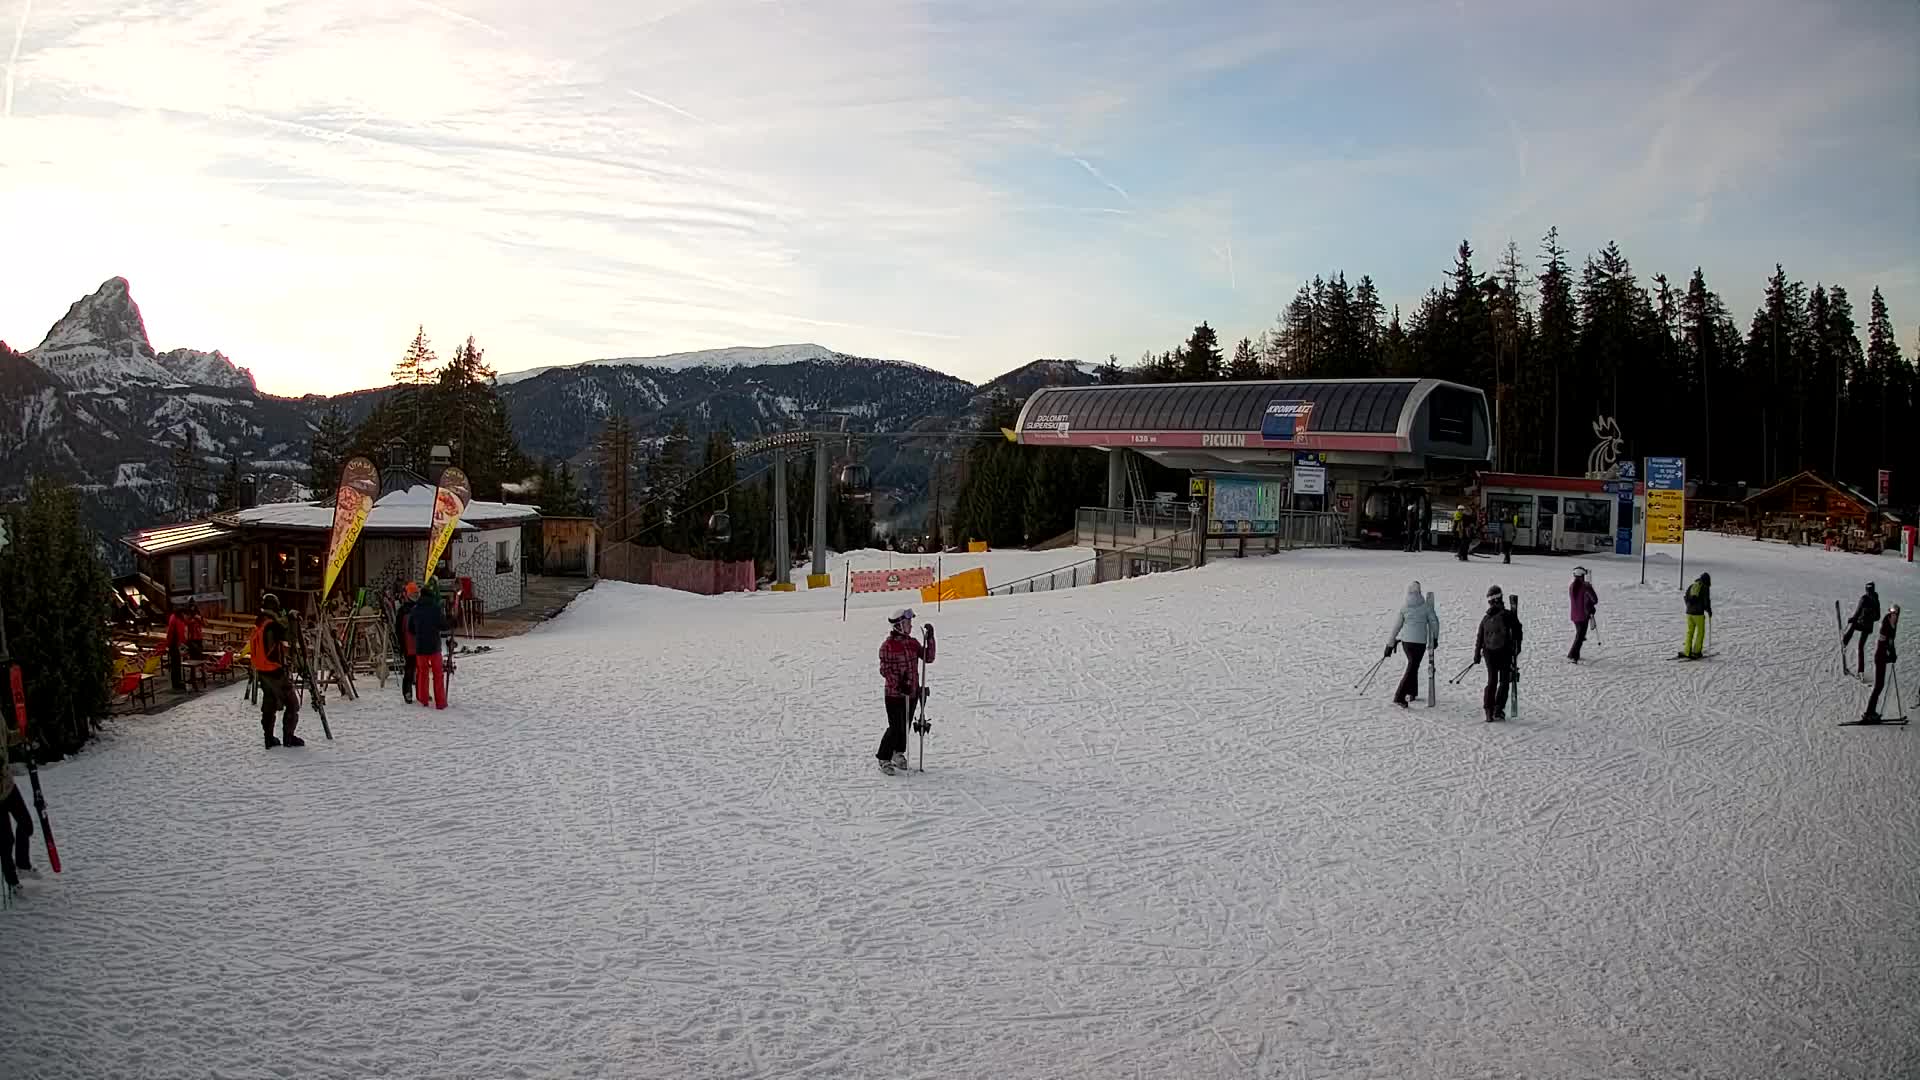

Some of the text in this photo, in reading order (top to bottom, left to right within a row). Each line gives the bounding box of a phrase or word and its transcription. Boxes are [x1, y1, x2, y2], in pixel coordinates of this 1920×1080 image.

[1036, 414, 1069, 422] DOLOMITI
[1026, 422, 1059, 430] SUPERSKI
[1202, 434, 1246, 447] PICULIN
[334, 515, 365, 569] PIZZERIA
